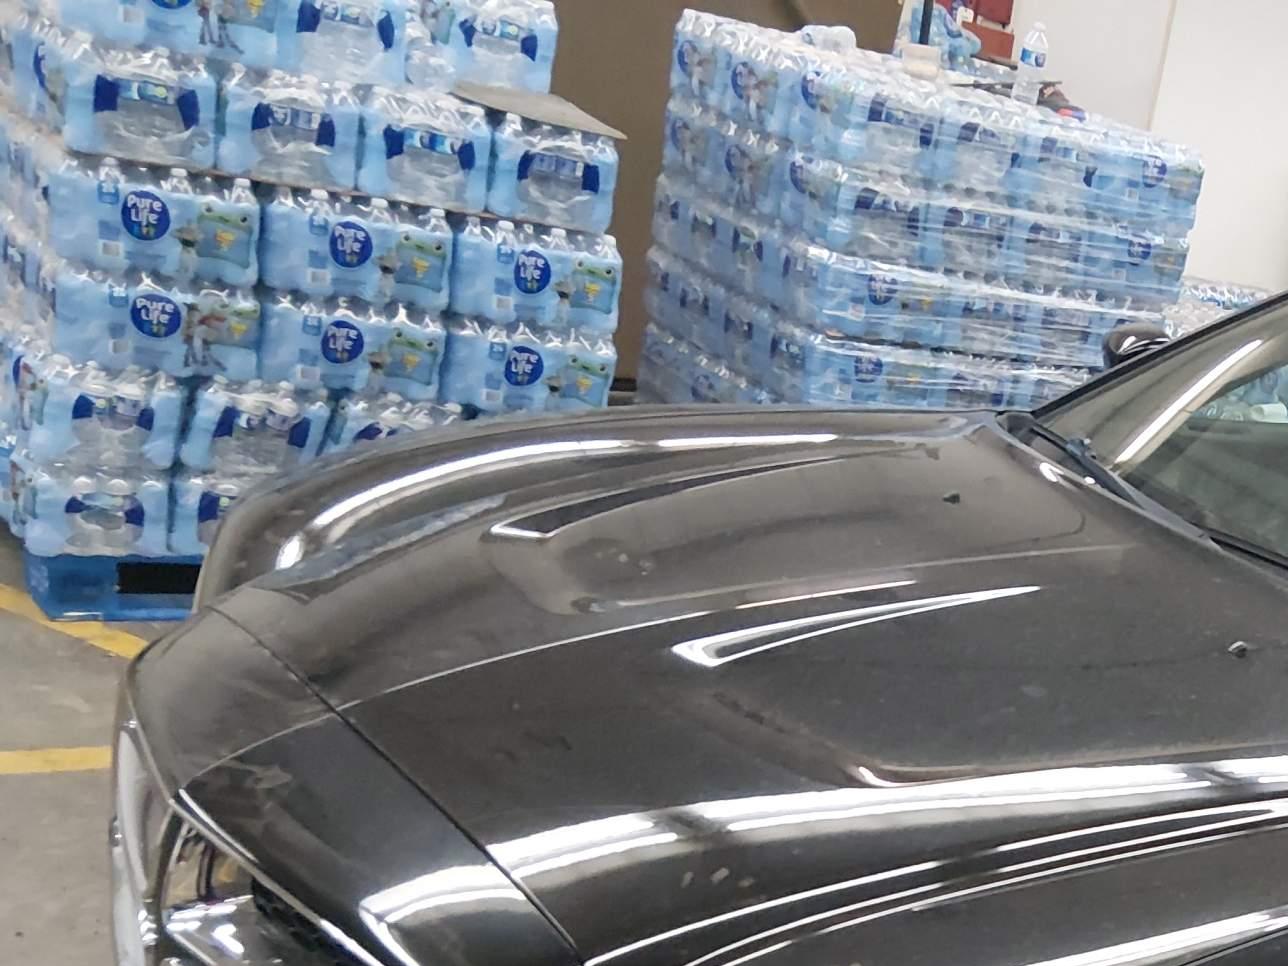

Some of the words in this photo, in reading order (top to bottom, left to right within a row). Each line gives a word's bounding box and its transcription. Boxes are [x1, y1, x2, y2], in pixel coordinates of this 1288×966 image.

[127, 194, 163, 212] Pure
[131, 209, 159, 227] Life
[335, 225, 367, 241] Pure
[337, 238, 361, 253] Life
[518, 254, 545, 268] Pure
[520, 266, 541, 280] Life
[136, 298, 174, 313] Pure
[141, 310, 171, 324] Life
[327, 325, 358, 339] Pure
[329, 337, 353, 351] Life
[510, 350, 538, 364] Pure
[511, 360, 533, 374] Life
